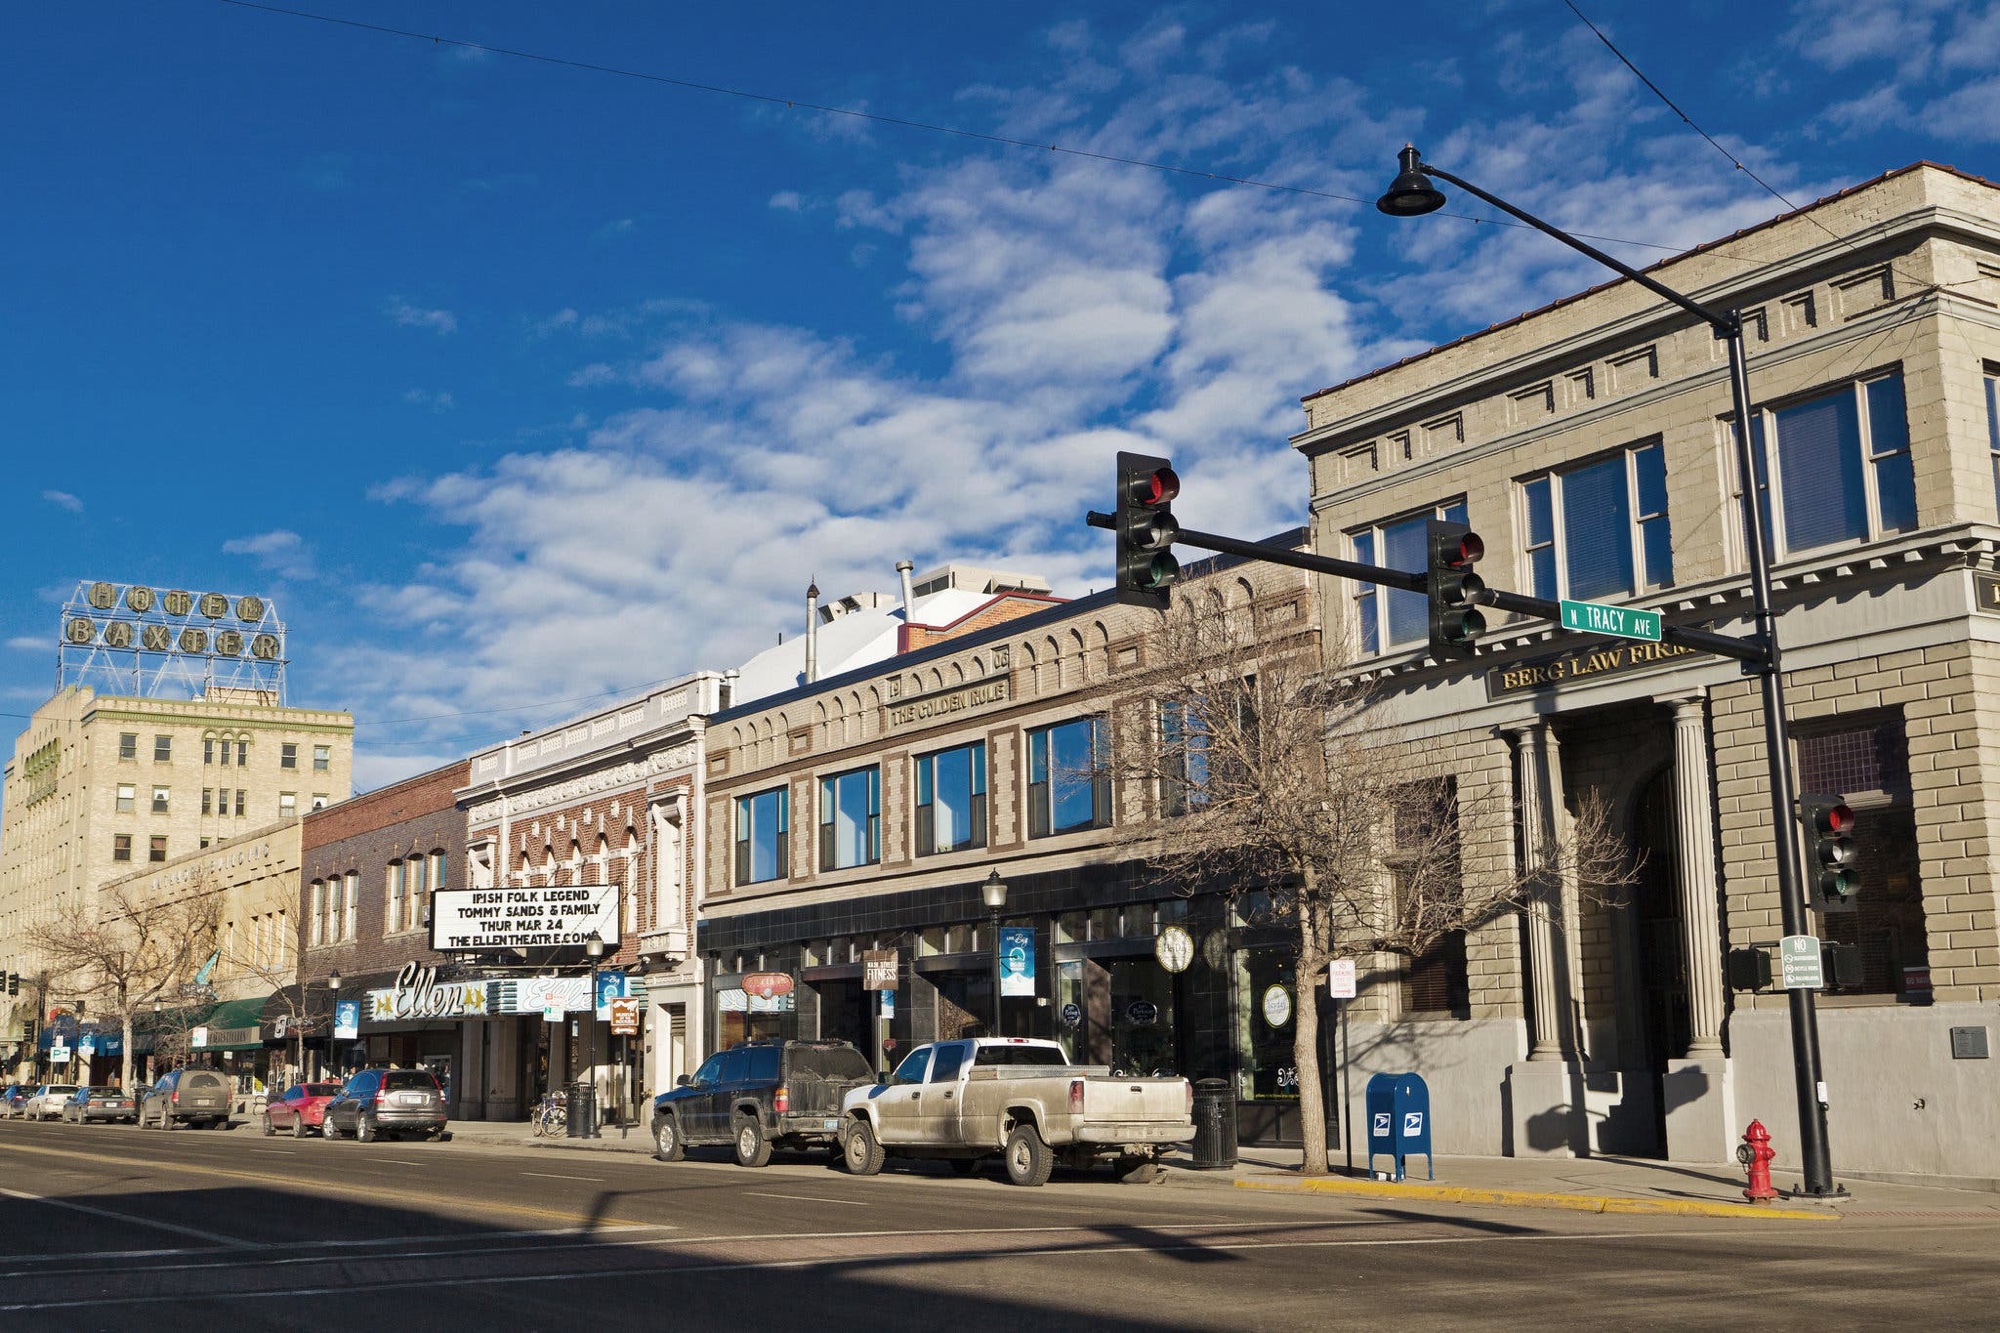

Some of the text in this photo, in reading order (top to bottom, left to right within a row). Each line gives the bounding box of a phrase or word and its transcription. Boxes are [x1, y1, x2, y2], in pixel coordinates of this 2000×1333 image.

[92, 583, 261, 621] HOTEL
[1570, 607, 1652, 636] N TRACY AVE
[72, 619, 279, 658] BAXTER
[1502, 662, 1565, 690] BERG
[1570, 649, 1623, 677] LAW
[892, 682, 1006, 727] THE GOLDEN RULE
[457, 903, 601, 919] TOMMY SANDS & FAMILY
[506, 891, 538, 903] FOLK
[543, 890, 590, 902] LEGEND
[480, 918, 564, 932] THUR MAR 24
[1794, 938, 1807, 951] NO
[394, 960, 465, 1018] Ellen
[867, 968, 896, 981] FITNESS
